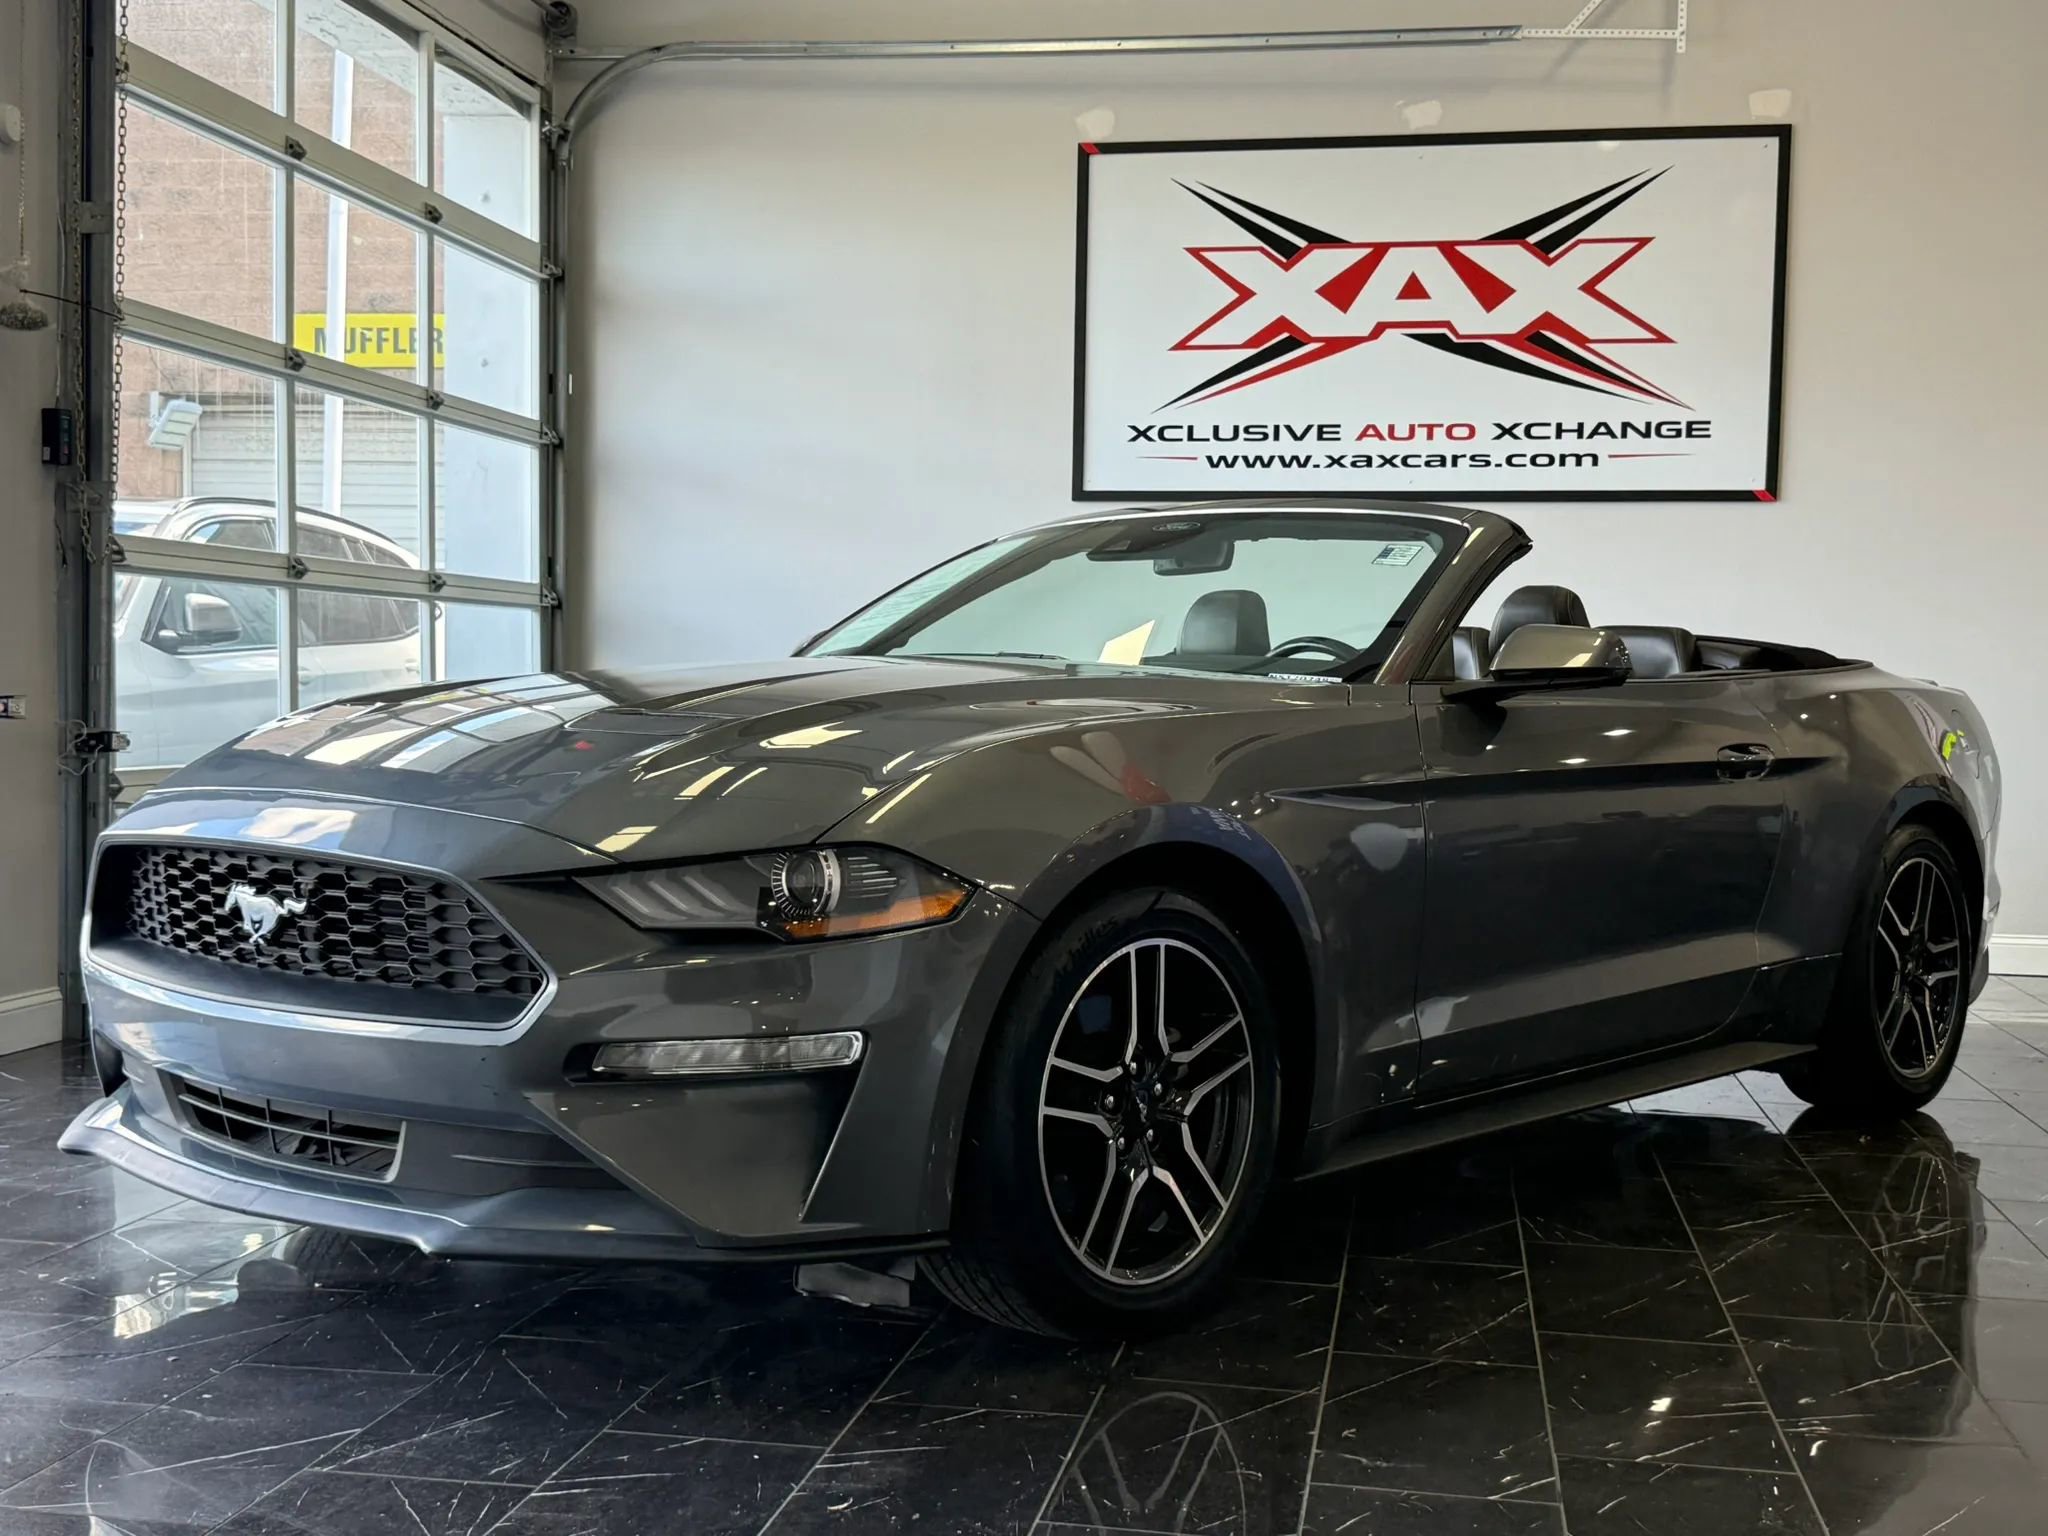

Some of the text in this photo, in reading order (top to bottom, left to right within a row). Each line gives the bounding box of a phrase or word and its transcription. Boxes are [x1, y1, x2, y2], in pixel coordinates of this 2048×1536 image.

[1167, 237, 1678, 351] XAX
[1127, 420, 1712, 442] XCLUSIVE AUTO XCHANGE
[1205, 452, 1600, 469] www.xaxcars.com
